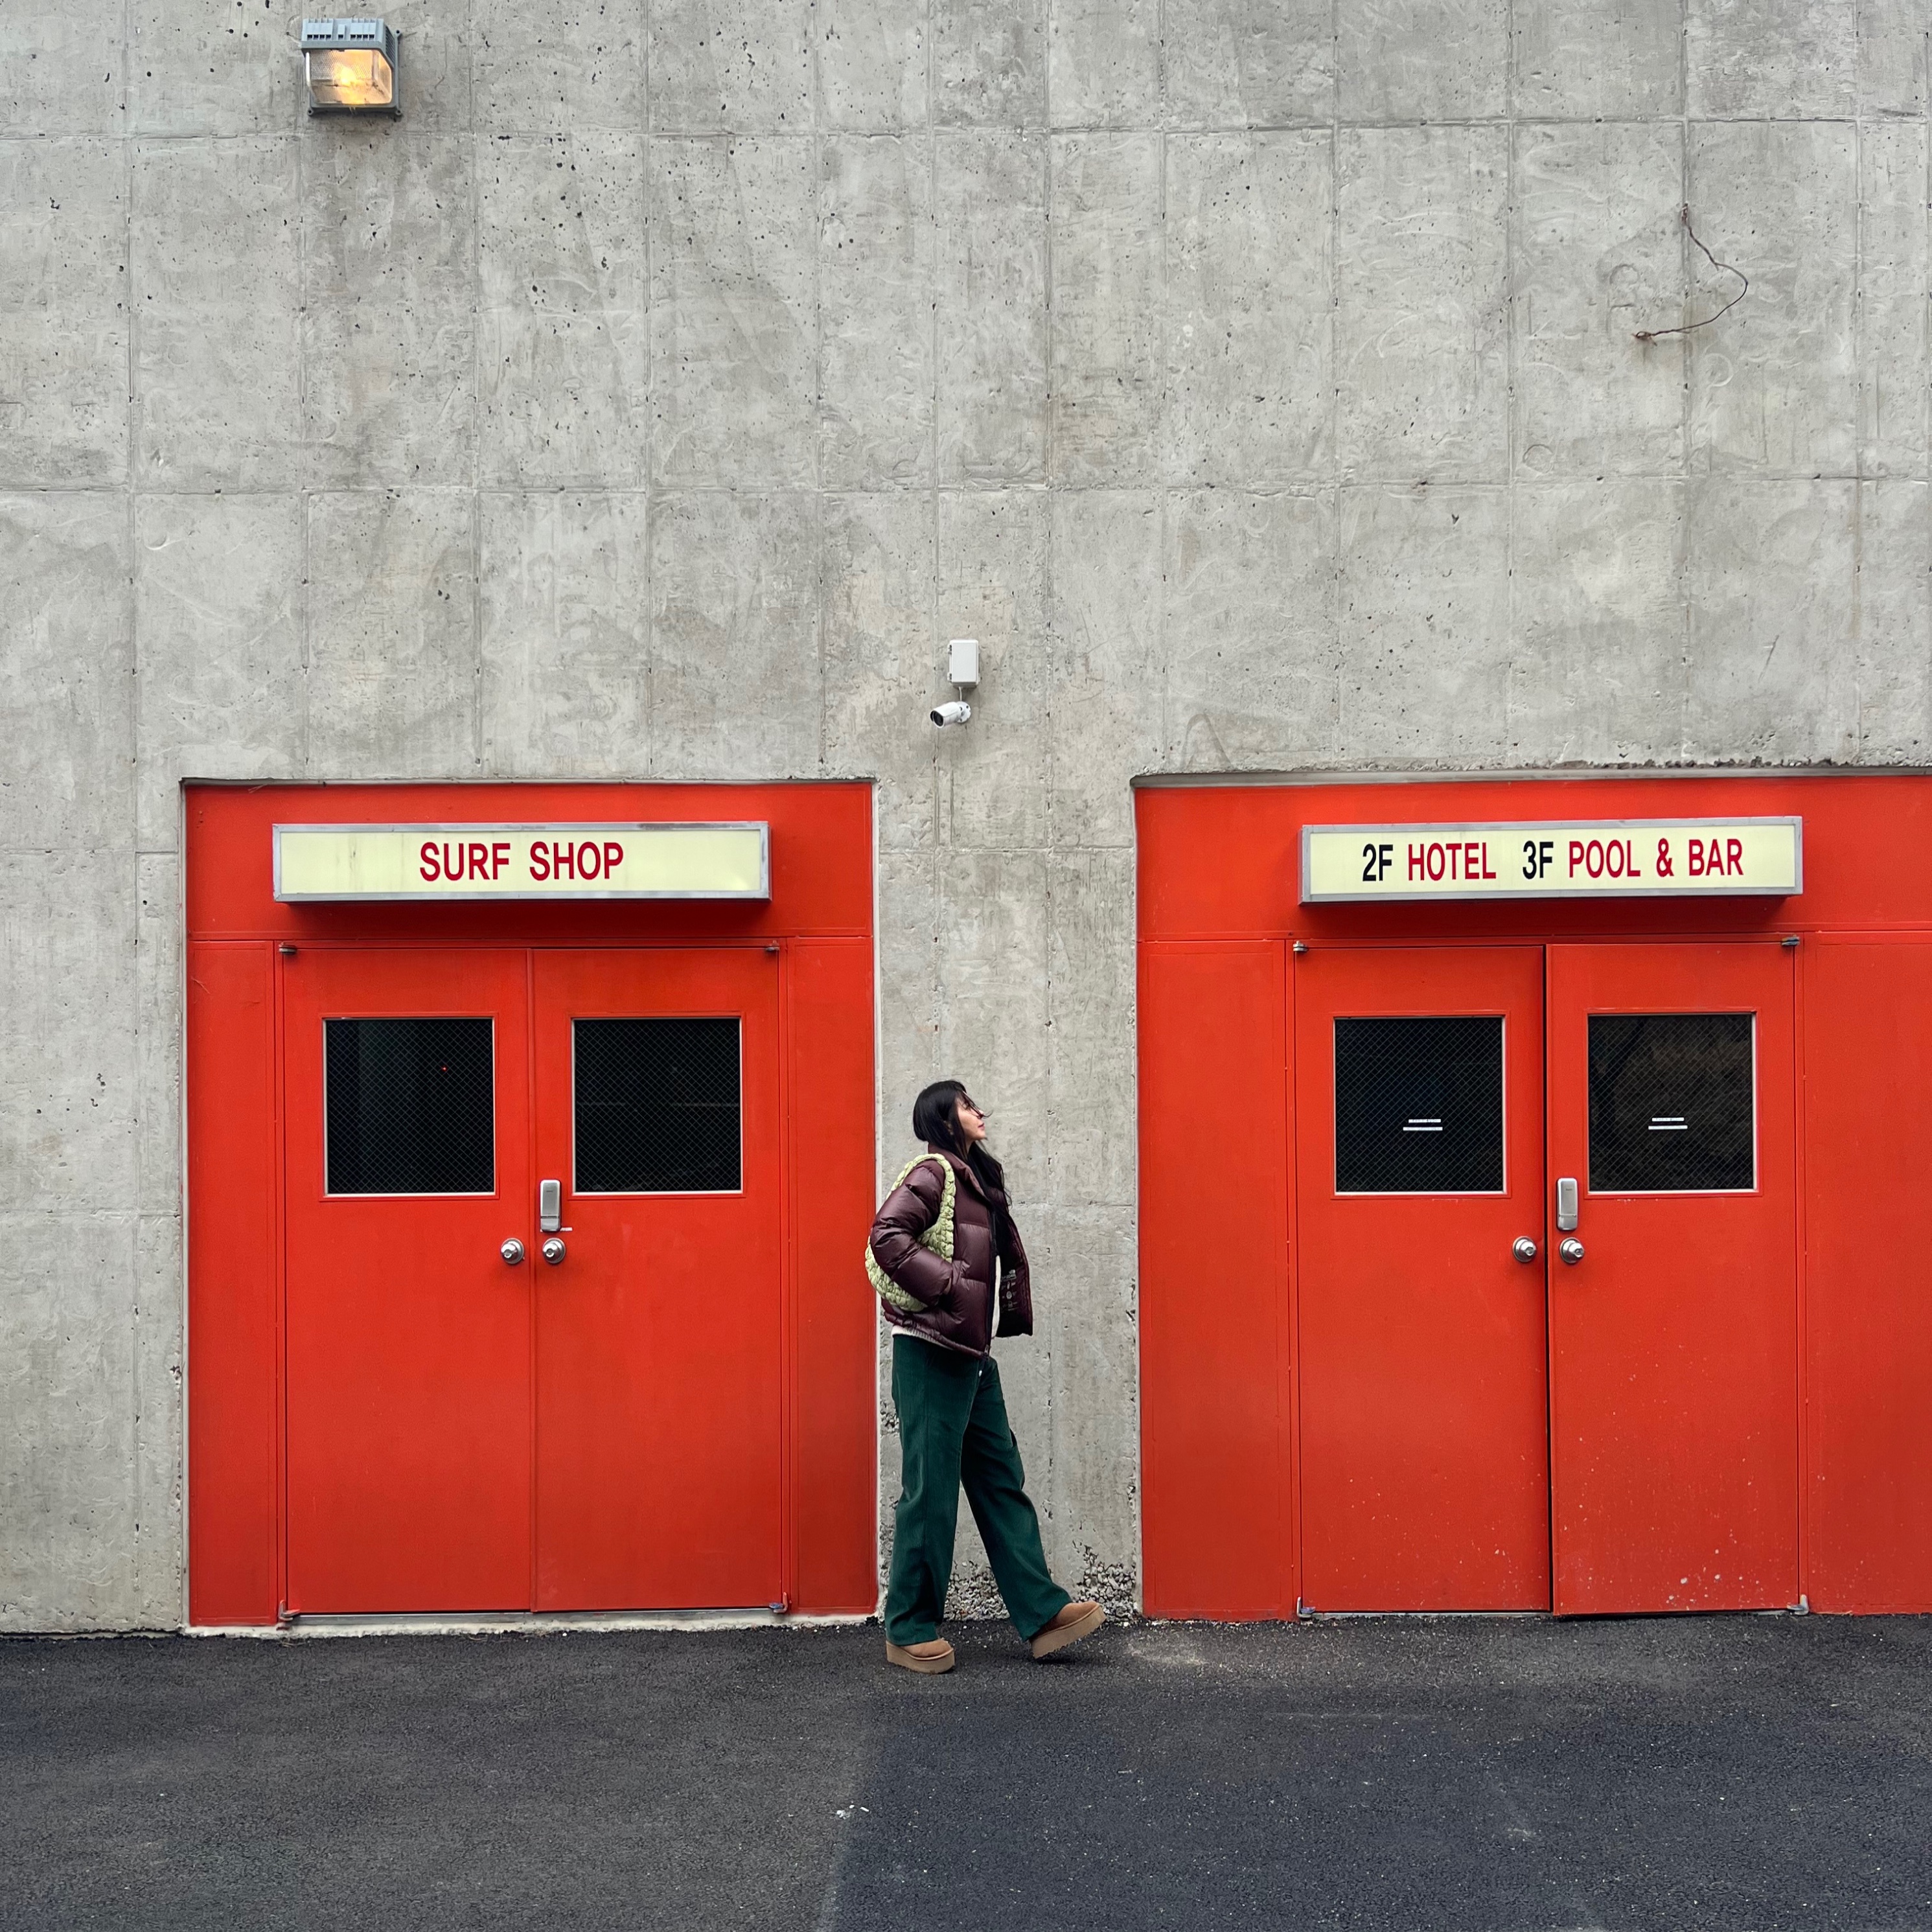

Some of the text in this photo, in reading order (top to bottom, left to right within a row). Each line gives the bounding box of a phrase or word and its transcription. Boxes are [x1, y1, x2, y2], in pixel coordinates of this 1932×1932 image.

[419, 841, 624, 882] SURF SHOP
[1362, 838, 1744, 882] 2F HOTEL 3F POOL & BAR
